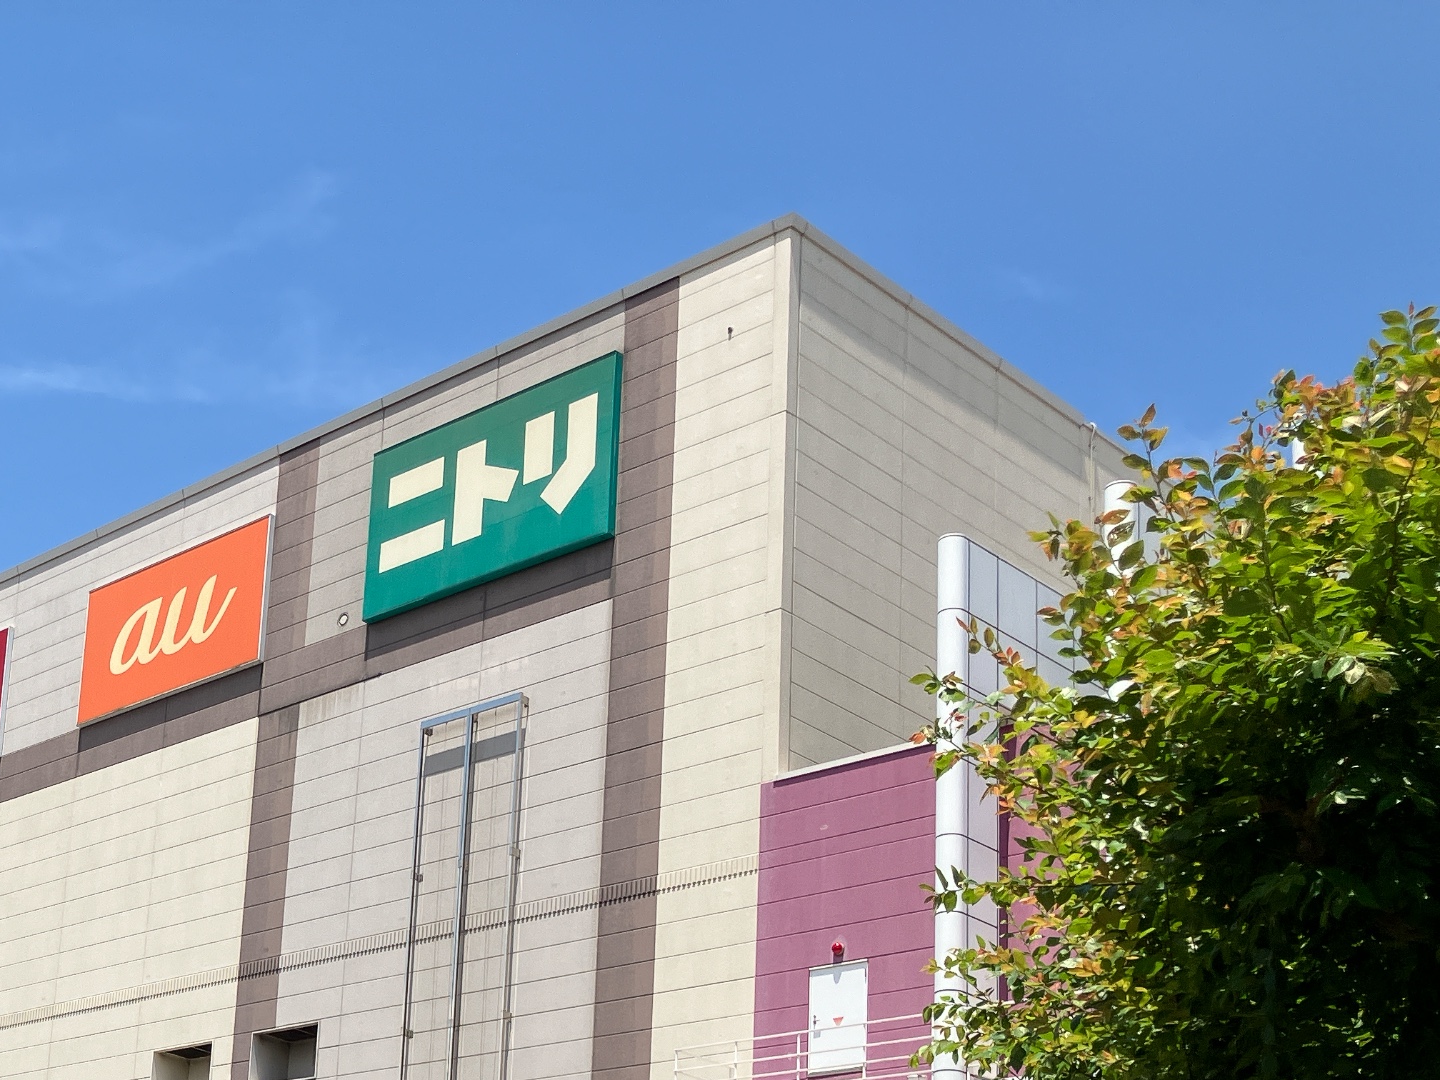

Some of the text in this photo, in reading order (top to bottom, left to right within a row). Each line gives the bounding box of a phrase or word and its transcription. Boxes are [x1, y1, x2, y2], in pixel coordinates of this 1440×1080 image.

[378, 392, 599, 574] ニトリ
[109, 574, 238, 675] au
